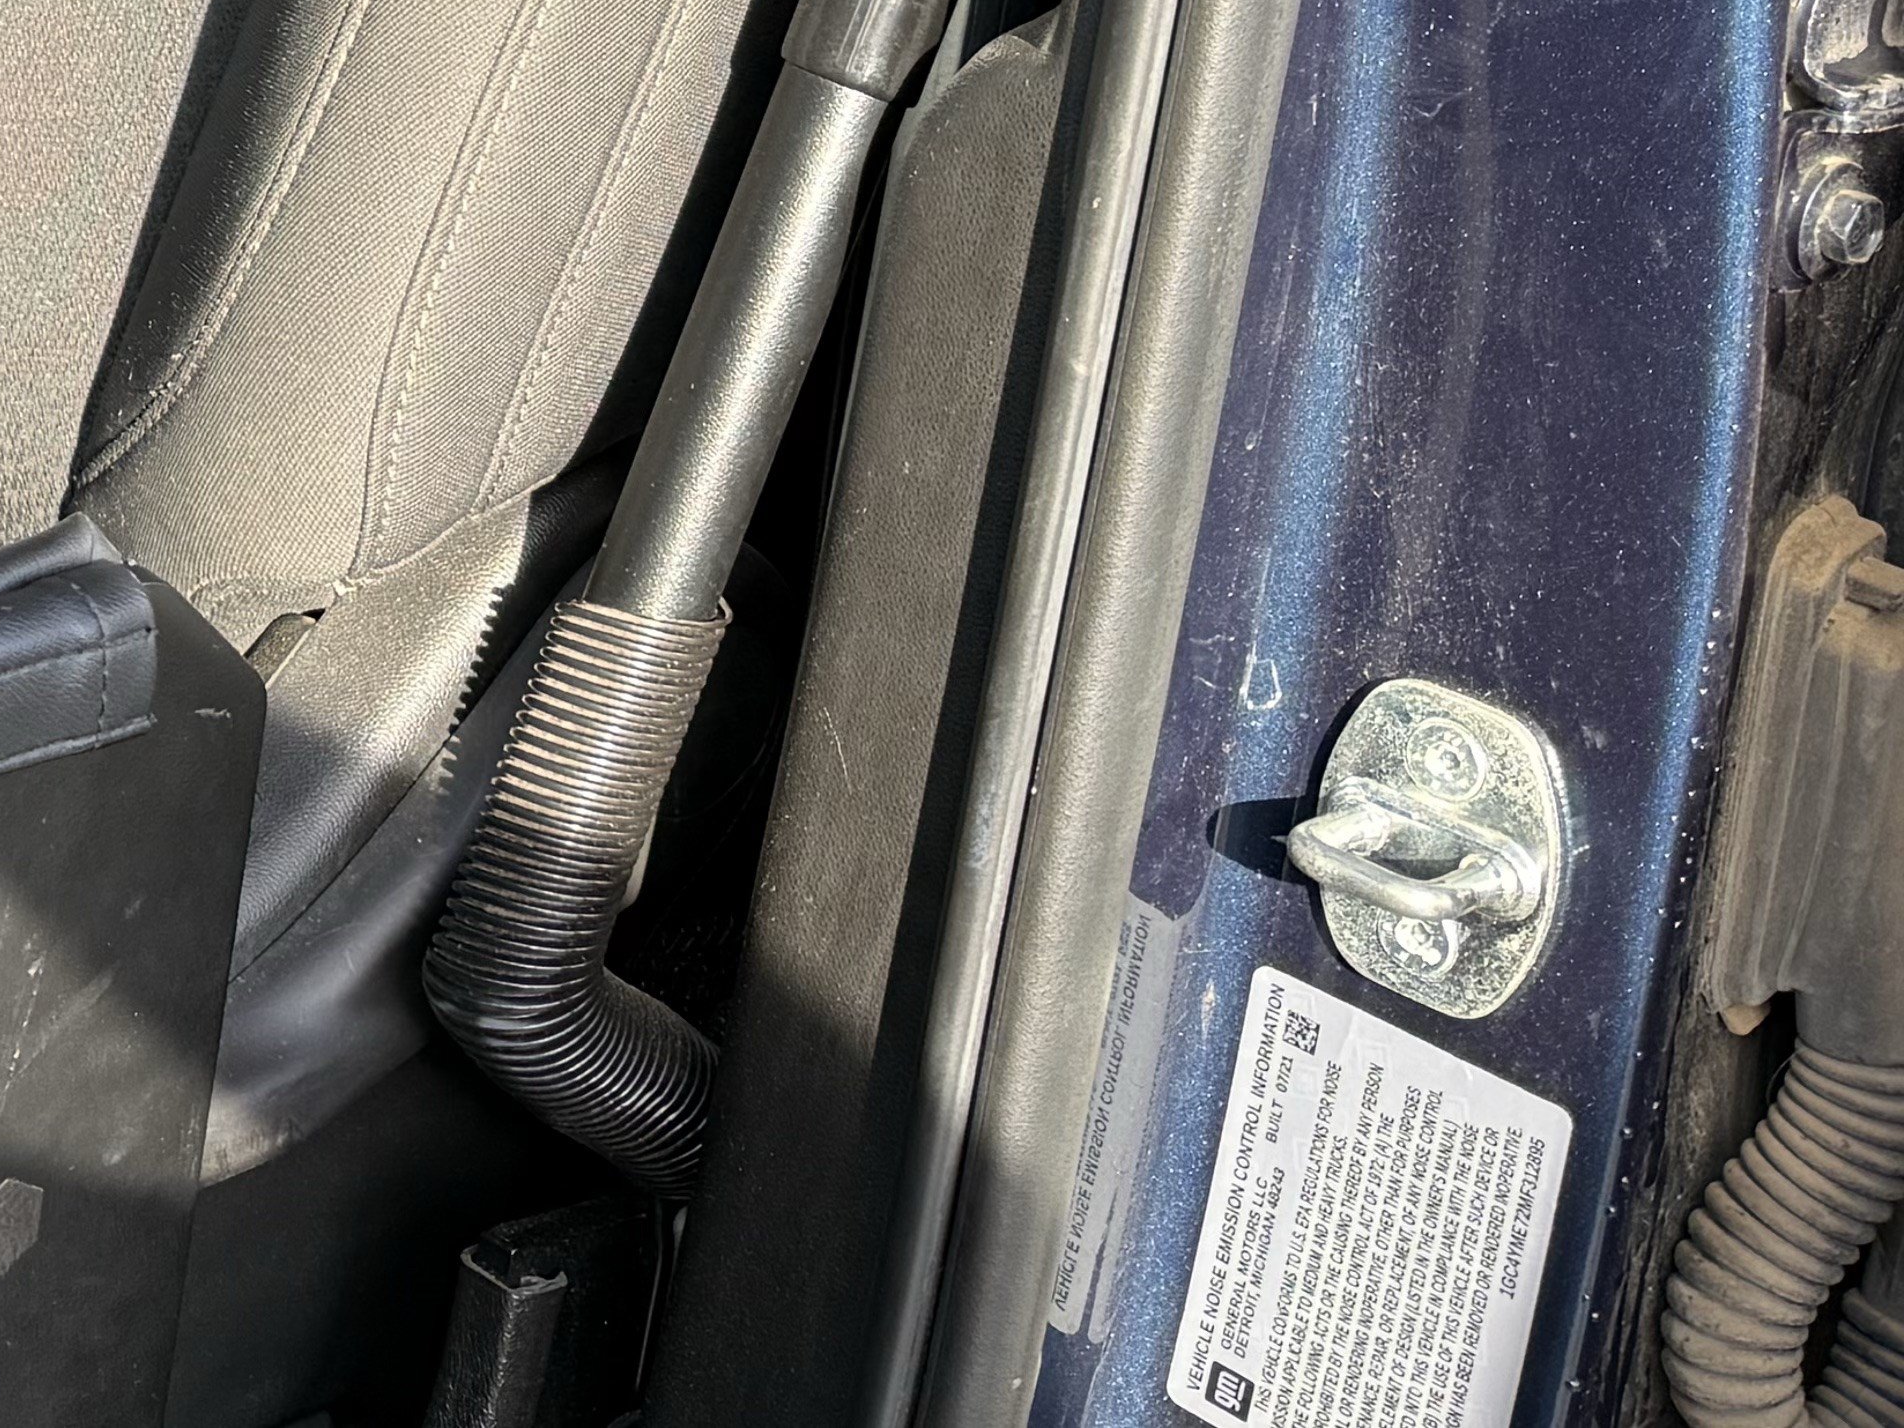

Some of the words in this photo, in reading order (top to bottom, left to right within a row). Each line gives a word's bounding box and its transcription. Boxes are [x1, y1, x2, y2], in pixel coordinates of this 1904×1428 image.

[1322, 1060, 1342, 1097] NOISE
[1361, 1062, 1384, 1113] PERSON
[1316, 1097, 1335, 1124] FOR
[1356, 1111, 1373, 1140] ANY
[1376, 1112, 1395, 1138] THE
[1396, 1085, 1421, 1151] PURPOSES
[1418, 1090, 1443, 1145] CONTROL
[1351, 1137, 1368, 1158] BY
[1373, 1137, 1394, 1159] (A)
[1434, 1119, 1462, 1175] MANUAL)
[1459, 1122, 1479, 1161] NOISE
[1483, 1126, 1500, 1147] OR
[1300, 1123, 1329, 1205] REGULATIONS
[1325, 1135, 1348, 1183] TRUCKS.
[1390, 1149, 1408, 1177] FOR
[1411, 1143, 1431, 1182] NOISE
[1453, 1159, 1472, 1184] THE
[1474, 1146, 1497, 1192] DEVICE
[1494, 1127, 1523, 1206] INOPERATIVE.
[1187, 1320, 1215, 1390] VEHICLE
[1203, 1265, 1227, 1319] NOISE
[1215, 1183, 1245, 1265] EMISSION
[1233, 1104, 1262, 1181] CONTROL
[1251, 983, 1285, 1098] INFORMATION
[1340, 1156, 1363, 1211] THEREOF
[1363, 1186, 1378, 1206] OF
[1383, 1175, 1403, 1209] THAN
[1405, 1181, 1423, 1209] ANY
[1422, 1173, 1446, 1229] OWNER'S
[1447, 1184, 1467, 1216] WITH
[1220, 1281, 1246, 1350] GENERAL
[1237, 1210, 1261, 1276] MOTORS
[1252, 1176, 1268, 1208] LLC
[1265, 1098, 1283, 1144] BUILT
[1275, 1055, 1294, 1093] 07/21
[1294, 1205, 1313, 1230] EPA
[1318, 1182, 1337, 1224] HEAVY
[1358, 1204, 1375, 1232] ACT
[1401, 1206, 1417, 1226] OF
[1466, 1190, 1486, 1226] SUCH
[1500, 1138, 1545, 1299] 1GC4YME72MF312895
[1289, 1230, 1307, 1253] U.S.
[1312, 1222, 1329, 1251] AND
[1329, 1211, 1353, 1265] CAUSING
[1375, 1209, 1396, 1251] OTHER
[1416, 1228, 1436, 1254] THE
[1459, 1225, 1480, 1266] AFTER
[1480, 1205, 1506, 1271] RENDERED
[1233, 1292, 1261, 1359] DETROIT,
[1250, 1211, 1276, 1289] MICHIGAN
[1267, 1166, 1285, 1210] 48243
[1285, 1252, 1302, 1270] TO
[1346, 1233, 1370, 1288] CONTROL
[1382, 1226, 1415, 1315] REPLACEMENT,
[1414, 1254, 1430, 1269] IN
[1431, 1216, 1460, 1293] COMPLIANCE
[1301, 1249, 1323, 1297] MEDIUM
[1323, 1264, 1342, 1288] THE
[1358, 1252, 1388, 1330] INOPERATIVE,
[1448, 1265, 1471, 1316] VEHICLE
[1475, 1270, 1493, 1290] OR
[1272, 1270, 1298, 1336] CONFORMS
[1296, 1295, 1313, 1314] TO
[1319, 1288, 1337, 1308] OR
[1338, 1286, 1358, 1325] NOISE
[1405, 1268, 1427, 1316] (LISTED
[1428, 1293, 1444, 1309] IN
[1313, 1307, 1332, 1342] ACTS
[1331, 1323, 1350, 1349] THE
[1378, 1313, 1395, 1334] OR
[1394, 1313, 1417, 1360] DESIGN
[1417, 1306, 1440, 1357] VEHICLE
[1440, 1315, 1461, 1344] THIS
[1462, 1289, 1488, 1350] REMOVED
[1261, 1335, 1284, 1385] VEHICLE
[1282, 1312, 1309, 1387] APPLICABLE
[1327, 1347, 1344, 1369] BY
[1342, 1329, 1369, 1399] RENDERING
[1367, 1336, 1393, 1381] REPAIR,
[1437, 1343, 1453, 1363] OF
[1455, 1348, 1476, 1383] BEEN
[1296, 1341, 1325, 1411] FOLLOWING
[1390, 1358, 1406, 1378] OF
[1410, 1358, 1429, 1386] THIS
[1432, 1362, 1451, 1389] USE
[1214, 1371, 1246, 1411] gm
[1254, 1386, 1272, 1413] THIS
[1338, 1397, 1355, 1418] OR
[1403, 1386, 1423, 1416] INTO
[1426, 1387, 1445, 1413] THE
[1449, 1381, 1469, 1410] HAS
